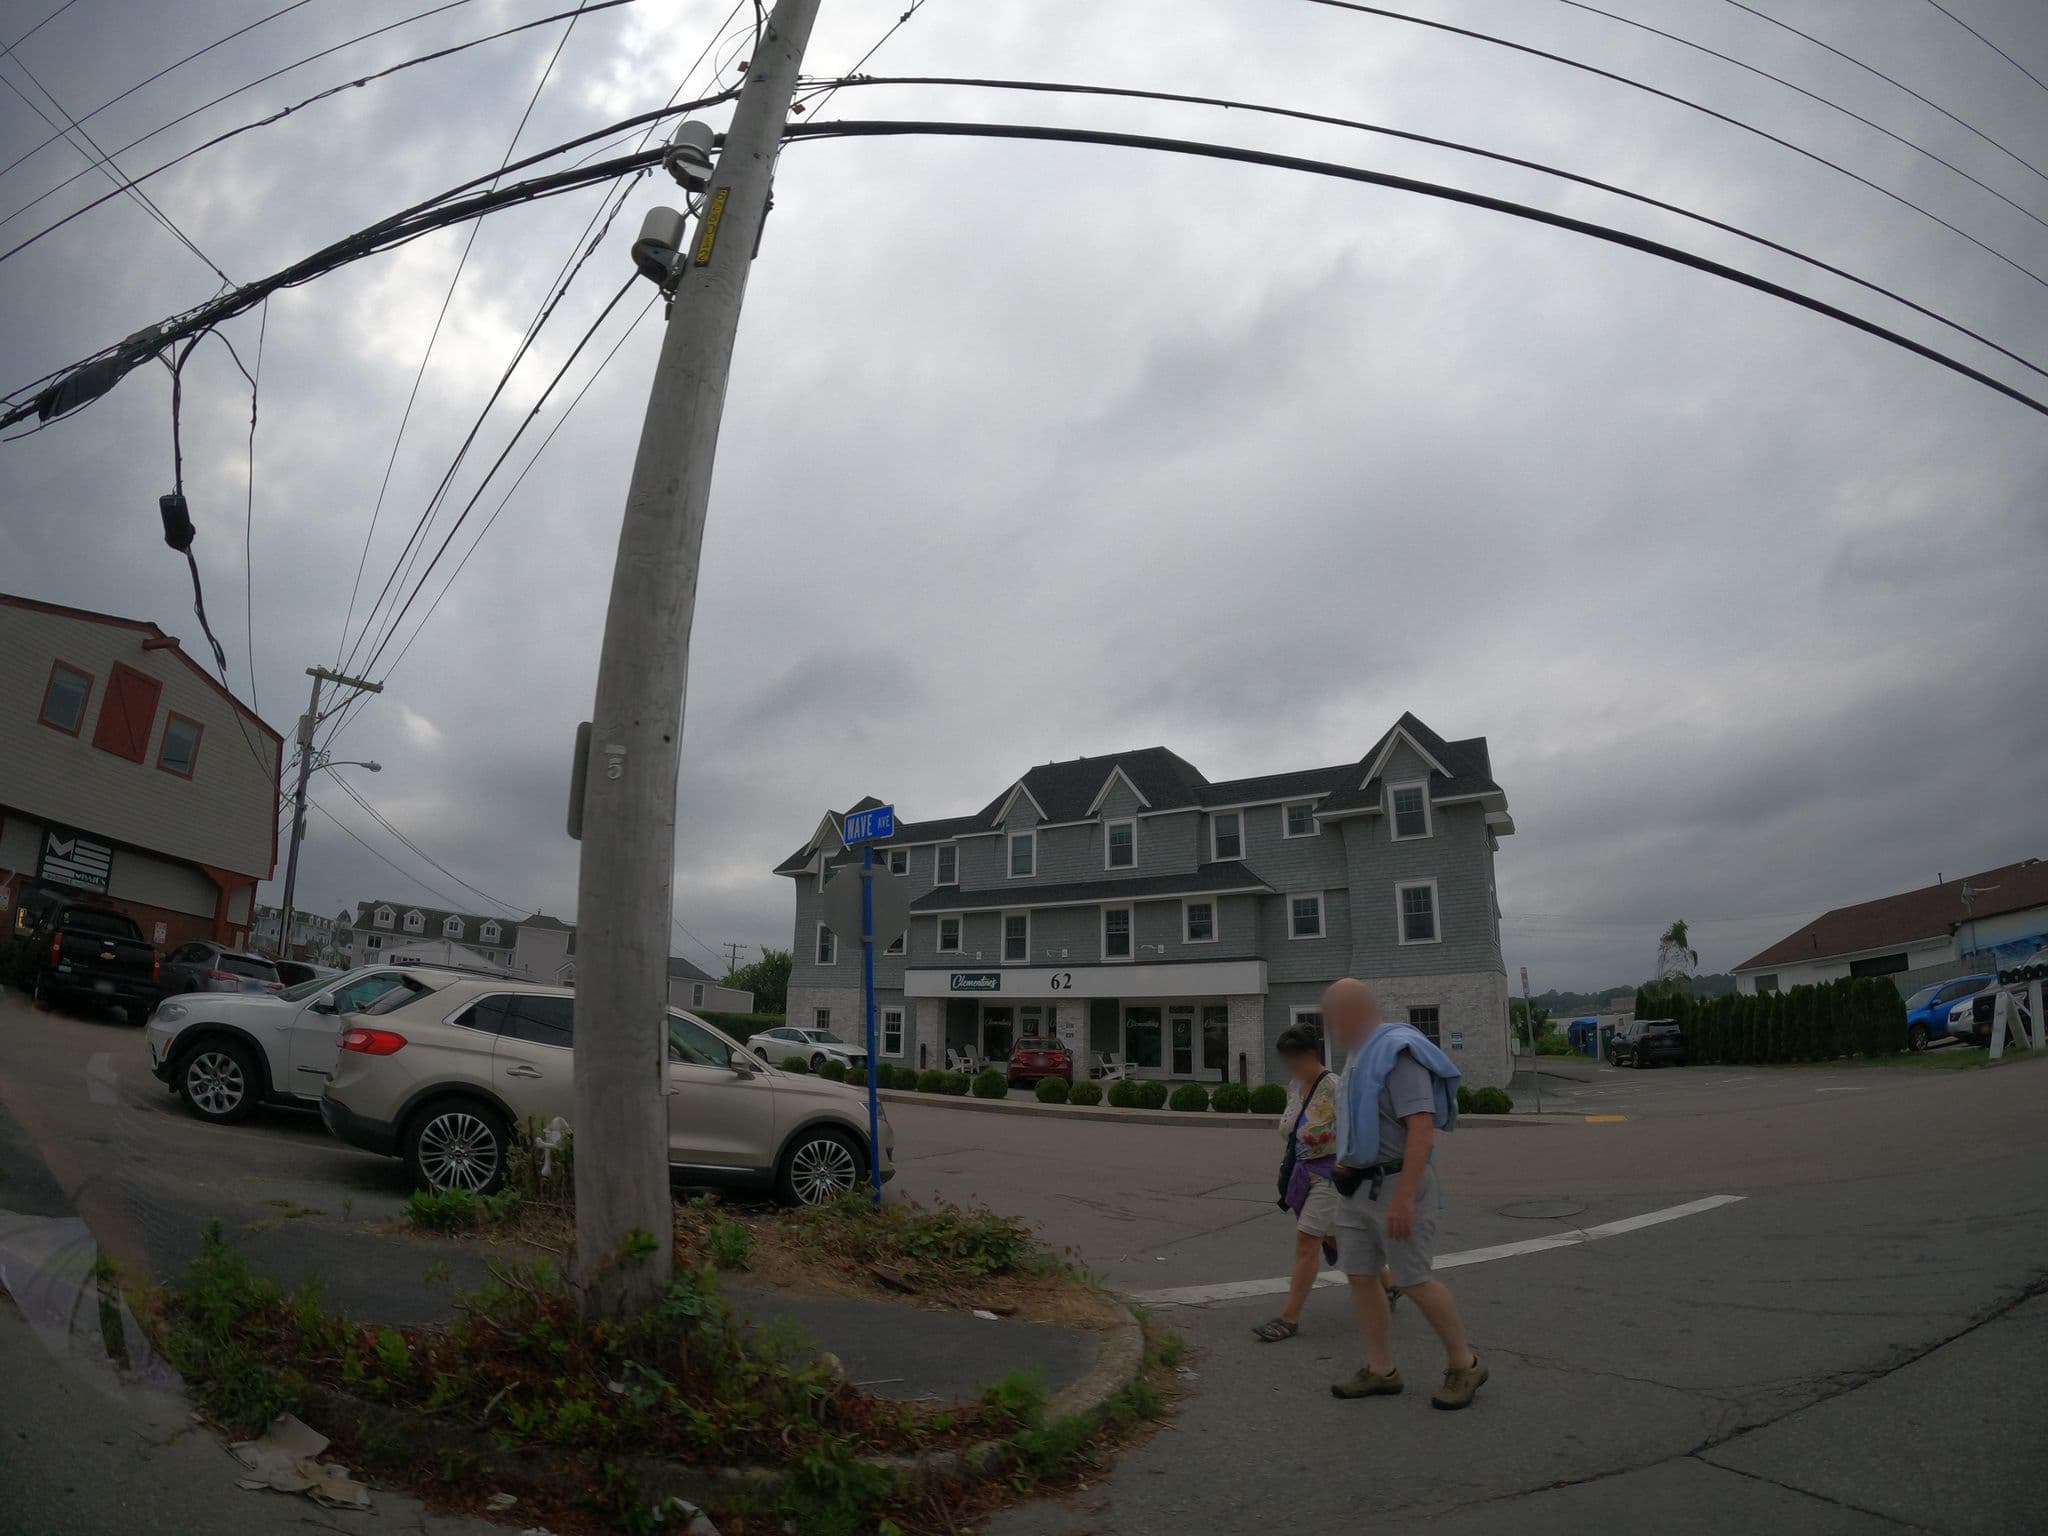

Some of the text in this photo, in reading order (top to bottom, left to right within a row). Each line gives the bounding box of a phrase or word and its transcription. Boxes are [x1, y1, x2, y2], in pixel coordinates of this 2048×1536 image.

[848, 815, 890, 841] WAVE AVE
[1051, 973, 1072, 990] 62
